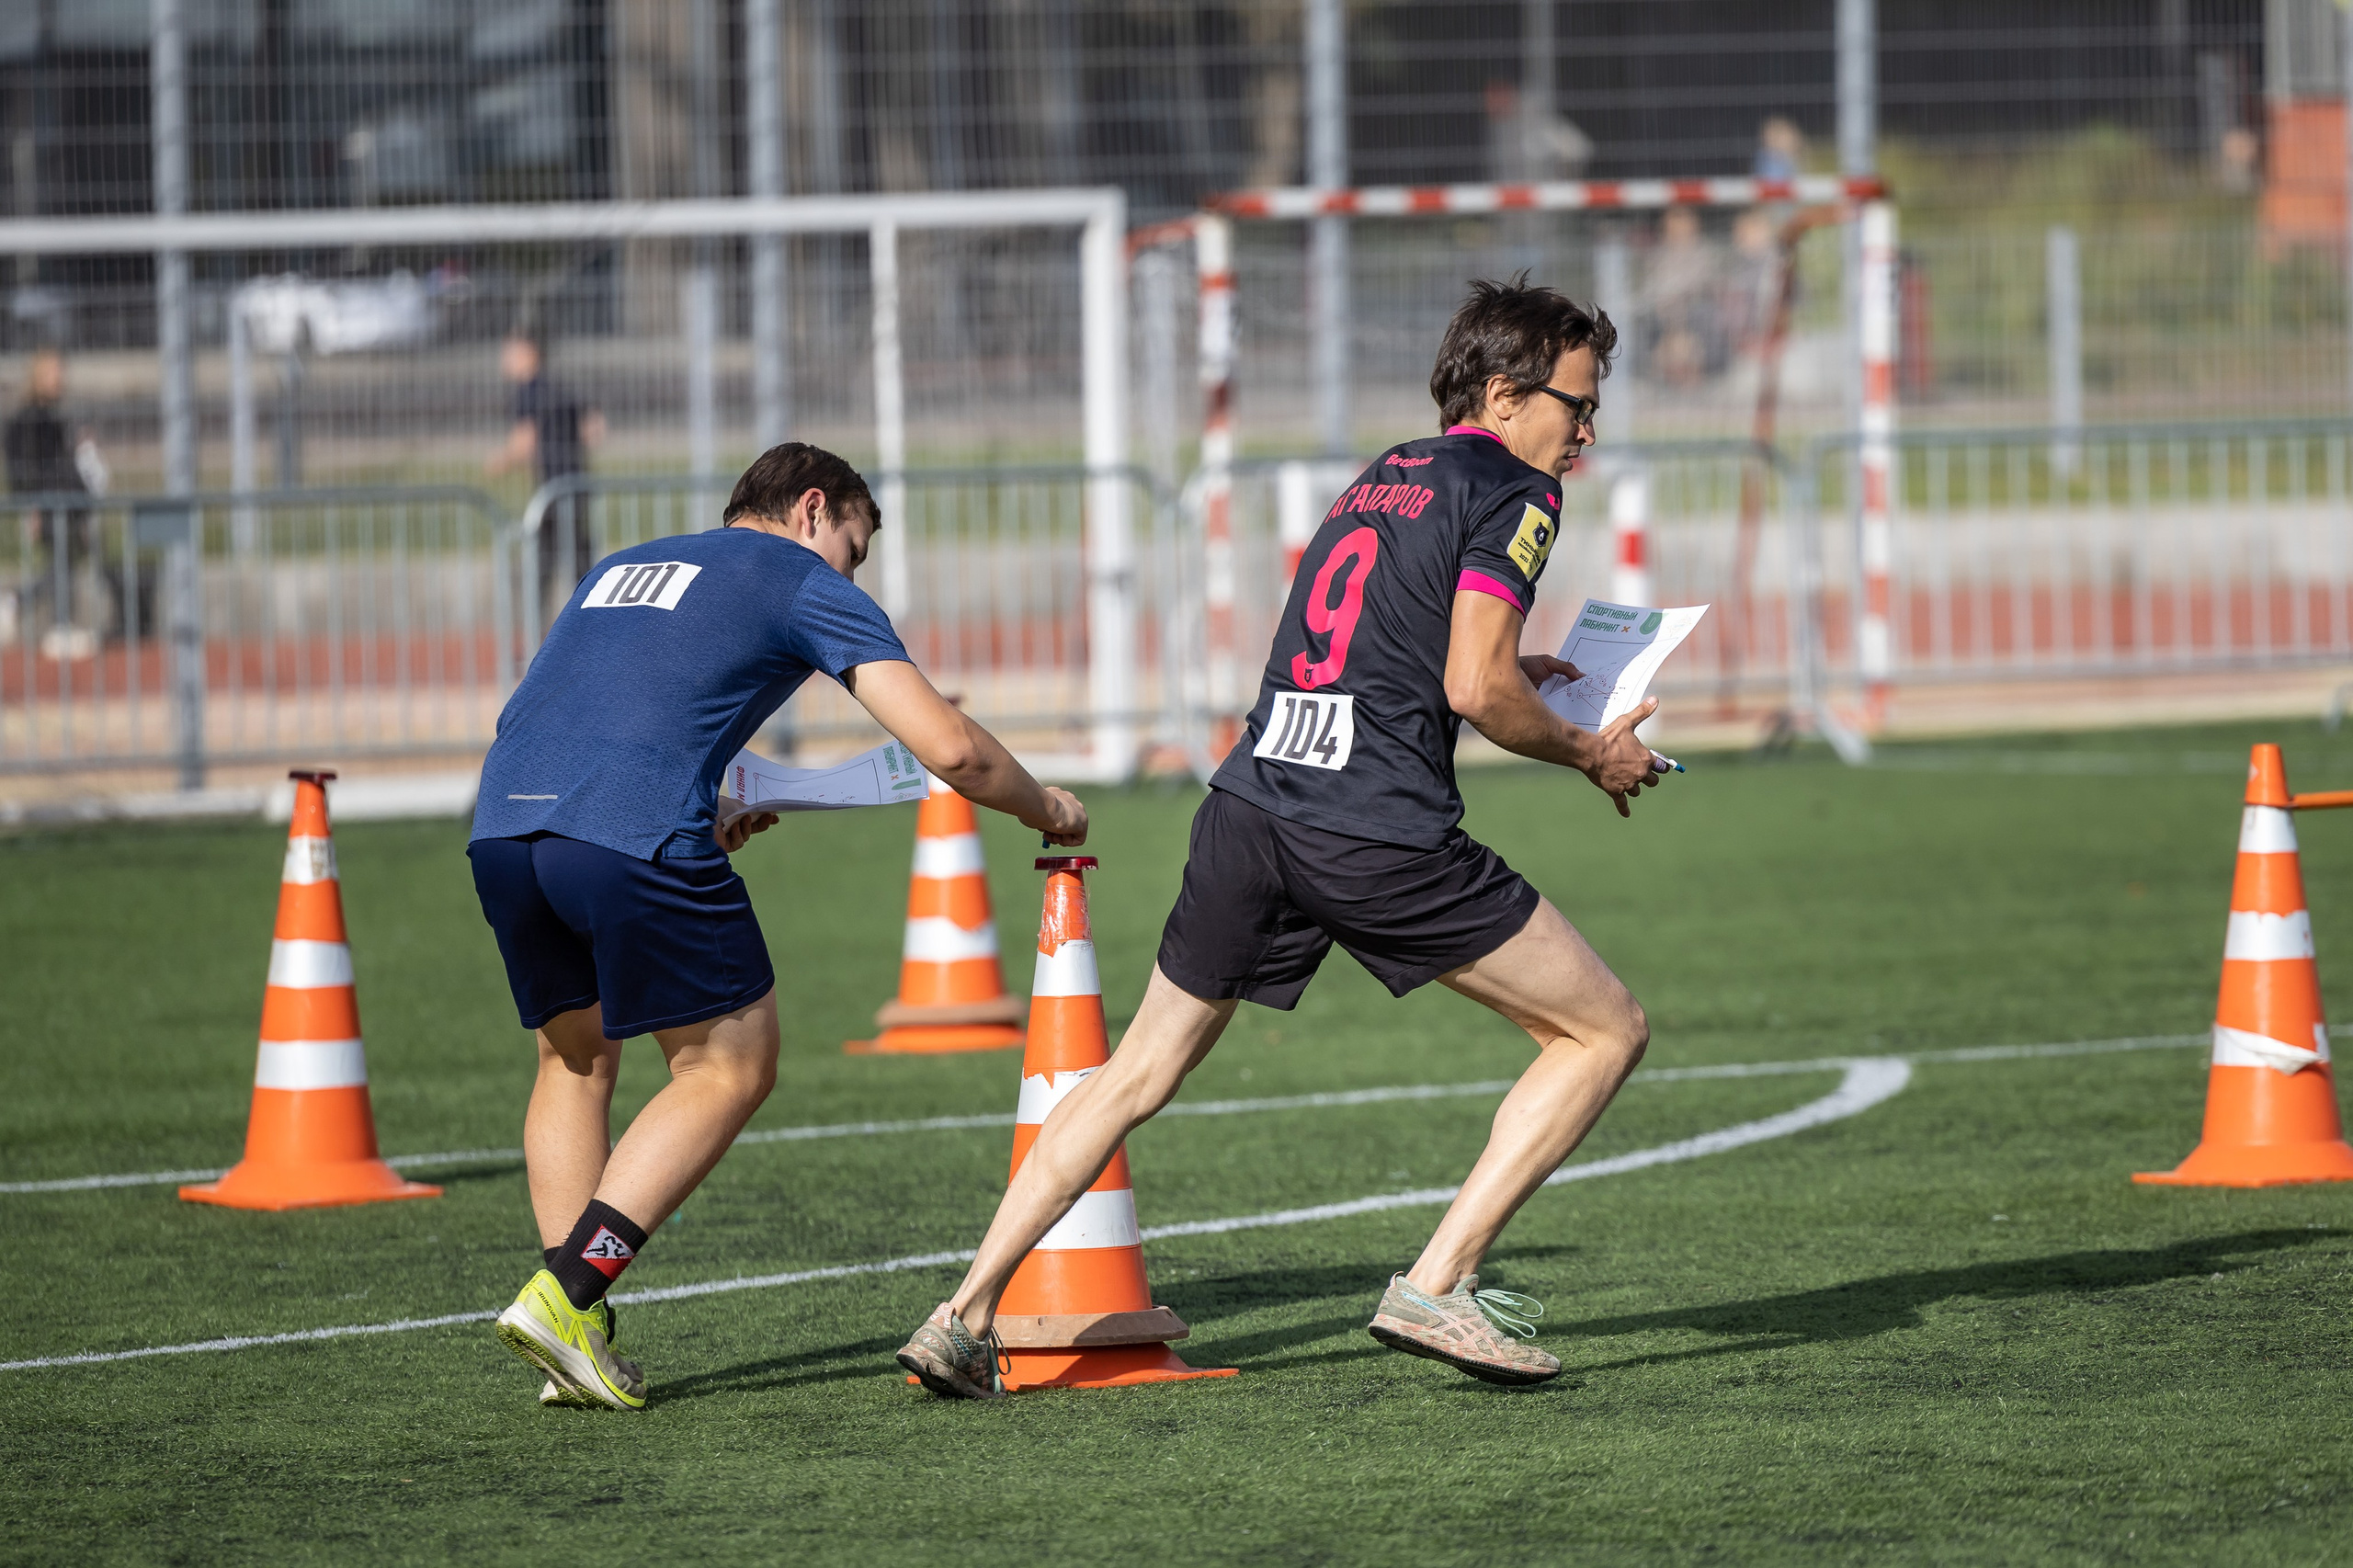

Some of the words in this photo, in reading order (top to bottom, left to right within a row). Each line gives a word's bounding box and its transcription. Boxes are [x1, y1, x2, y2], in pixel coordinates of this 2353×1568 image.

[1384, 453, 1434, 468] BetBoom
[604, 563, 681, 605] 101
[1290, 527, 1379, 690] 9
[1586, 604, 1639, 621] СПОРТИВНЫЙ
[1579, 618, 1620, 633] ЛАБИРИНТ
[1270, 698, 1338, 765] 104
[898, 741, 918, 776] ОРТИВНЫЙ
[736, 766, 745, 792] ФИНАЛ
